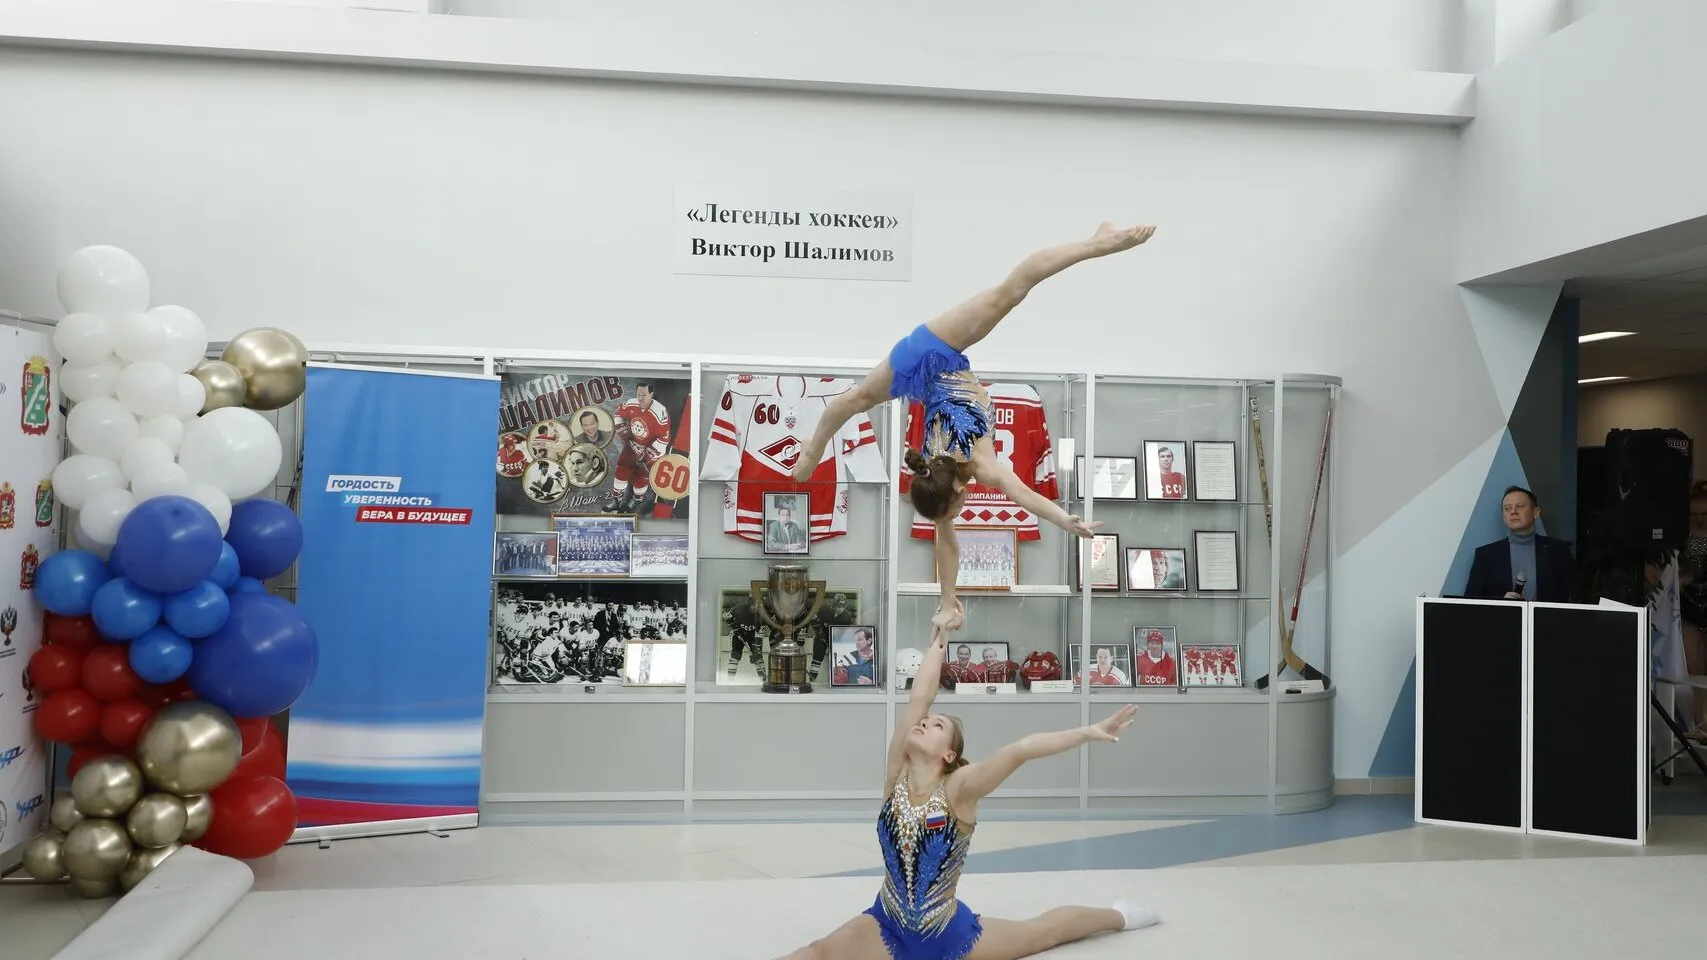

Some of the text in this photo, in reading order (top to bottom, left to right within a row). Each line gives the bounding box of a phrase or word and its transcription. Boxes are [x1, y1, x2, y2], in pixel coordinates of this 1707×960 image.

[686, 203, 899, 229] «Легенды хоккея»
[691, 237, 895, 262] Виктор Шалимов
[754, 403, 780, 425] 60
[995, 408, 1014, 425] ОВ
[331, 479, 395, 490] ГОРДОСТЬ
[654, 460, 690, 493] 60
[344, 494, 432, 506] УВЕРЕННОСТЬ
[361, 510, 467, 522] ВЕРА В БУДУЩЕЕ
[1144, 675, 1167, 684] СССР
